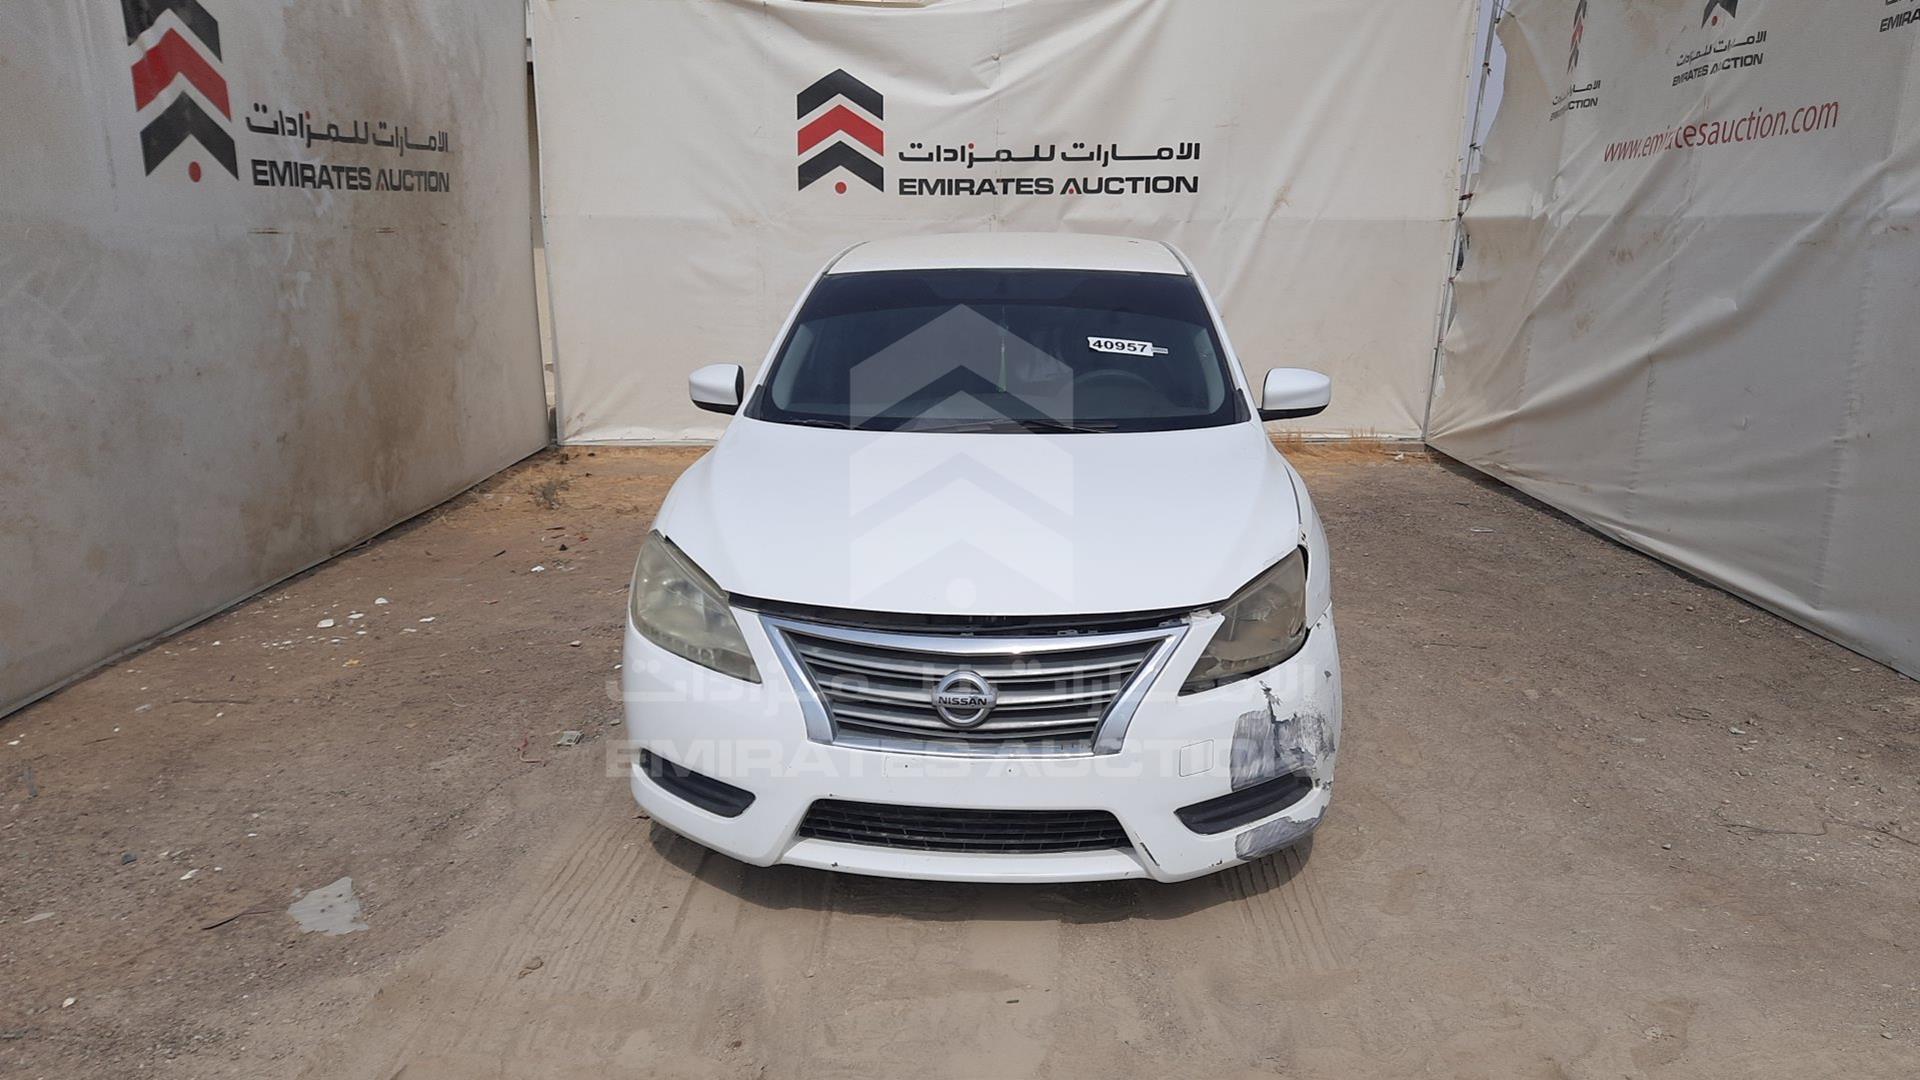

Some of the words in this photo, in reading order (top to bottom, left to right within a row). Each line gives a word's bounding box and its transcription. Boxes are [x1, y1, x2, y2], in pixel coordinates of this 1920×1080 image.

[1710, 53, 1763, 75] ACTION
[246, 102, 369, 149] للمزادات
[372, 121, 449, 157] الامارات
[898, 143, 1056, 169] للمزادات
[1061, 142, 1200, 168] الامارات
[251, 158, 372, 191] EMIRATES
[375, 168, 450, 193] AUCTION
[898, 177, 1054, 196] EMIRATES
[1060, 175, 1199, 195] AUCTION
[1091, 339, 1149, 353] 40957
[938, 696, 988, 706] NISSAN
